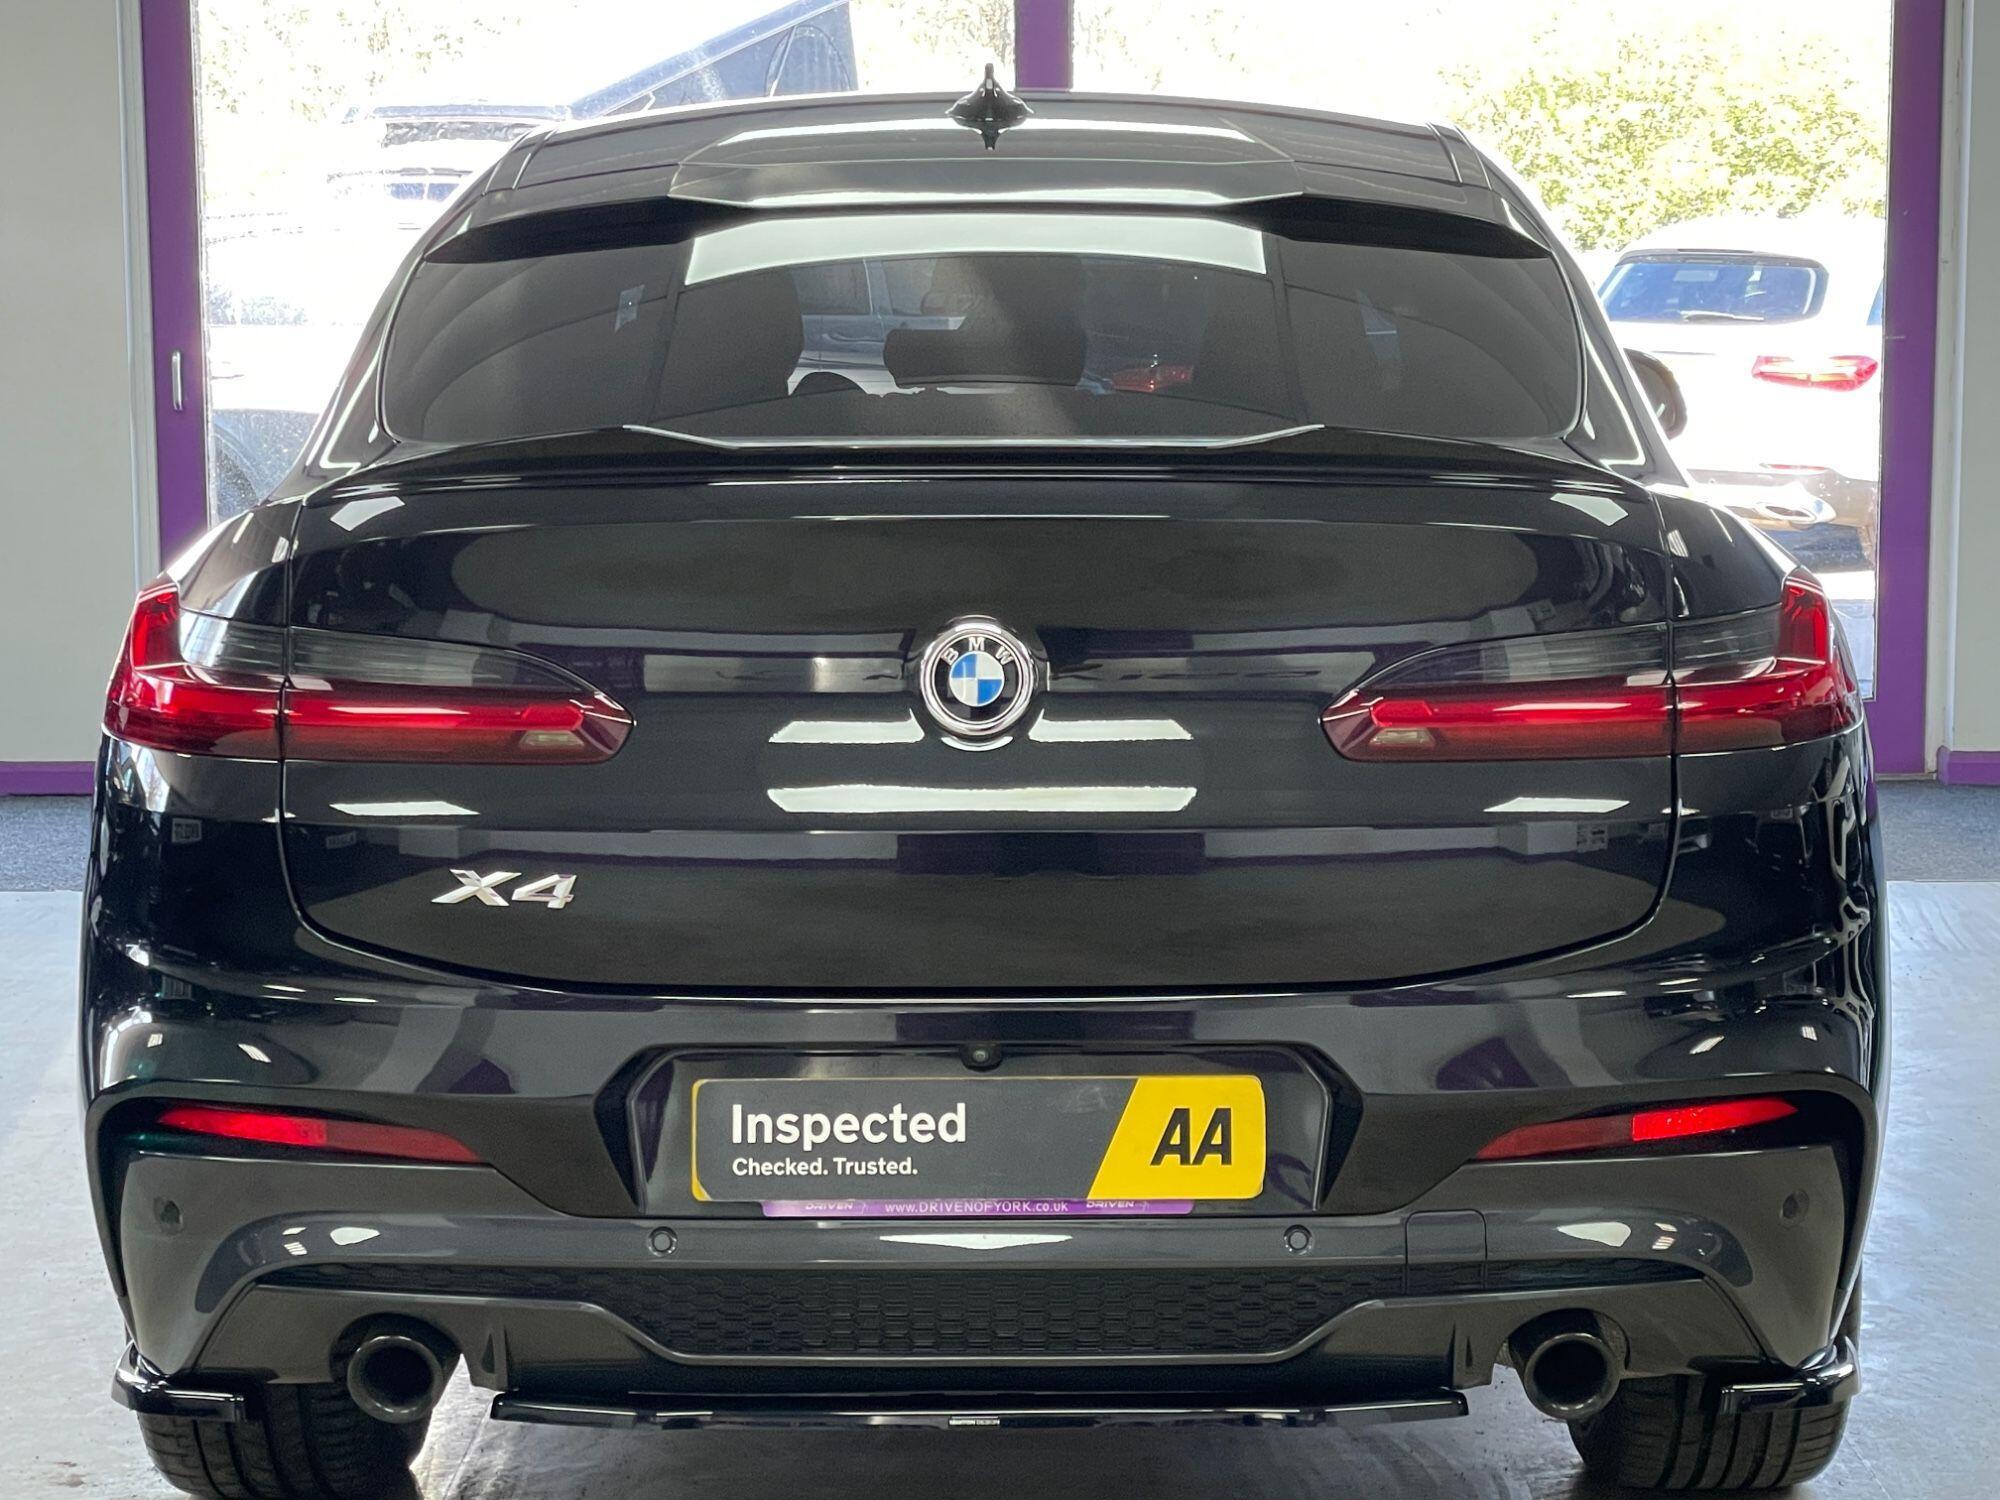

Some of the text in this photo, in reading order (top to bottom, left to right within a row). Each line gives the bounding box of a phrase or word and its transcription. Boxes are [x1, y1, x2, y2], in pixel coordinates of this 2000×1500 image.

[941, 637, 1014, 665] BMW
[431, 868, 577, 909] X4
[732, 1102, 966, 1151] Inspected
[1150, 1107, 1232, 1165] AA
[732, 1156, 918, 1176] Checked. Trusted.
[885, 1201, 1069, 1213] www.DRIVENOFYORK.co.uk
